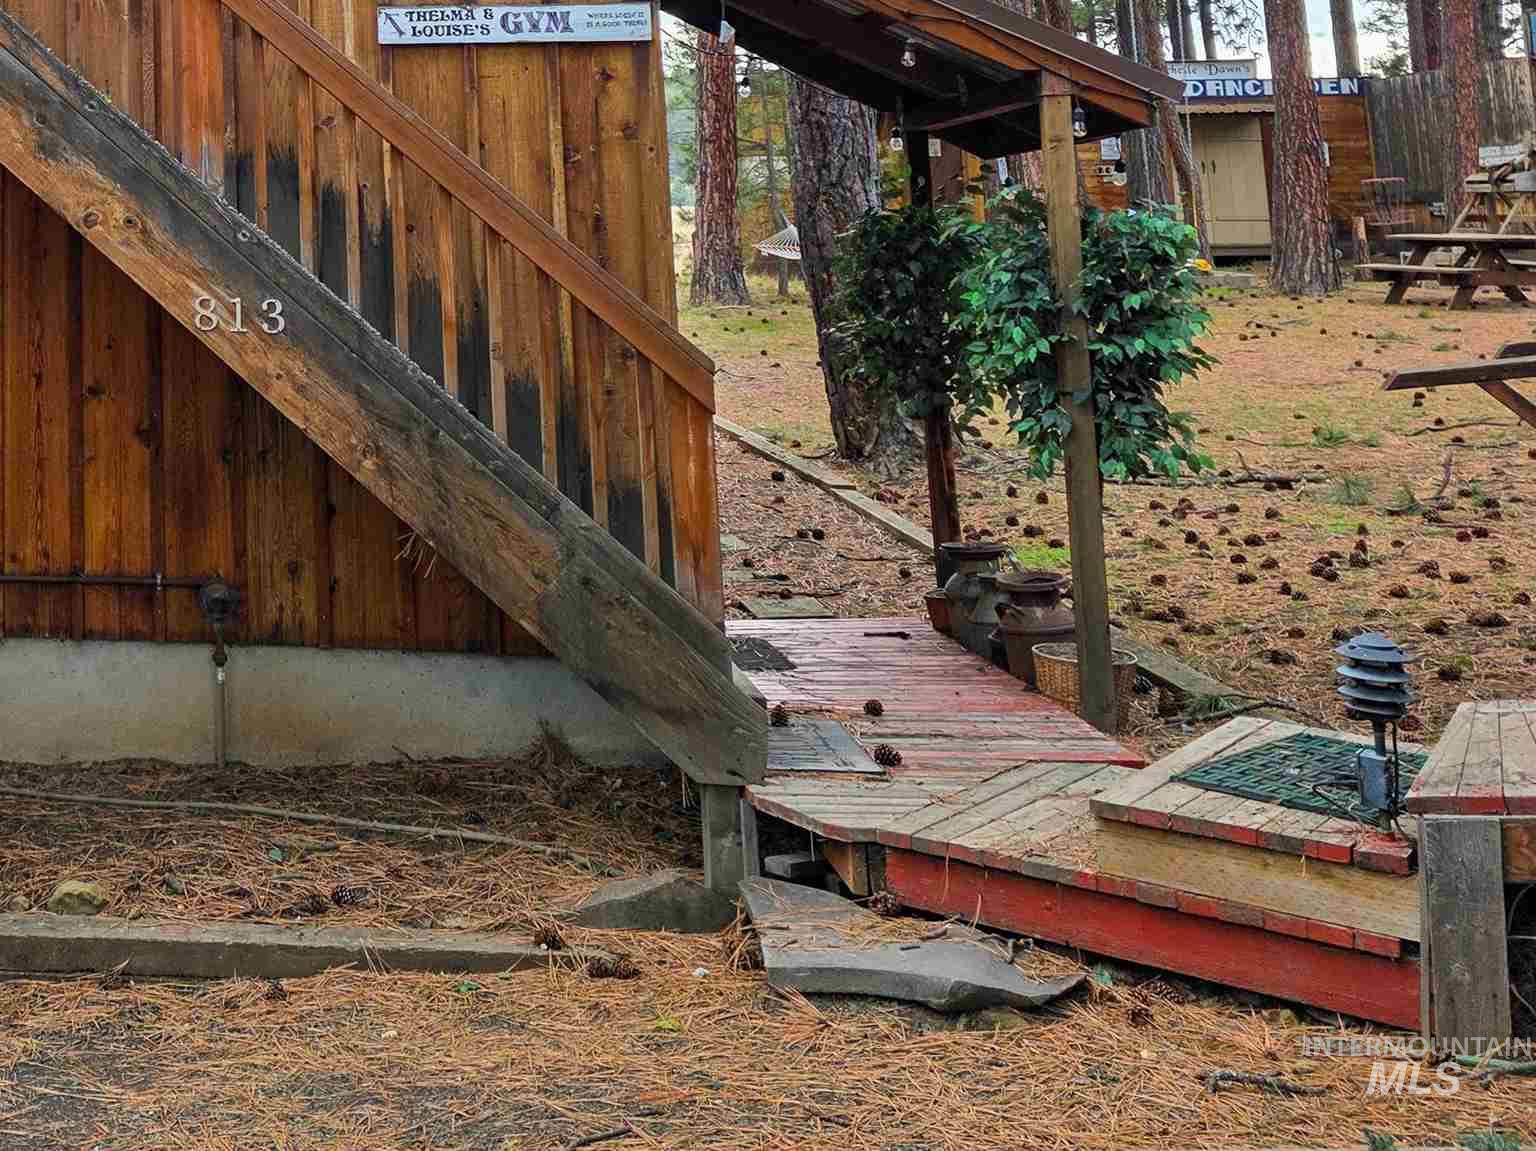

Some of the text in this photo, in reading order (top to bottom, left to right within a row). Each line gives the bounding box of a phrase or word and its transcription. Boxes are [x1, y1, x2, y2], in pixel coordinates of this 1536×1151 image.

[405, 8, 495, 22] THELMA &
[499, 11, 575, 35] GYM
[411, 24, 491, 37] LOUISE'S
[1314, 77, 1359, 96] EN
[194, 295, 285, 334] 813
